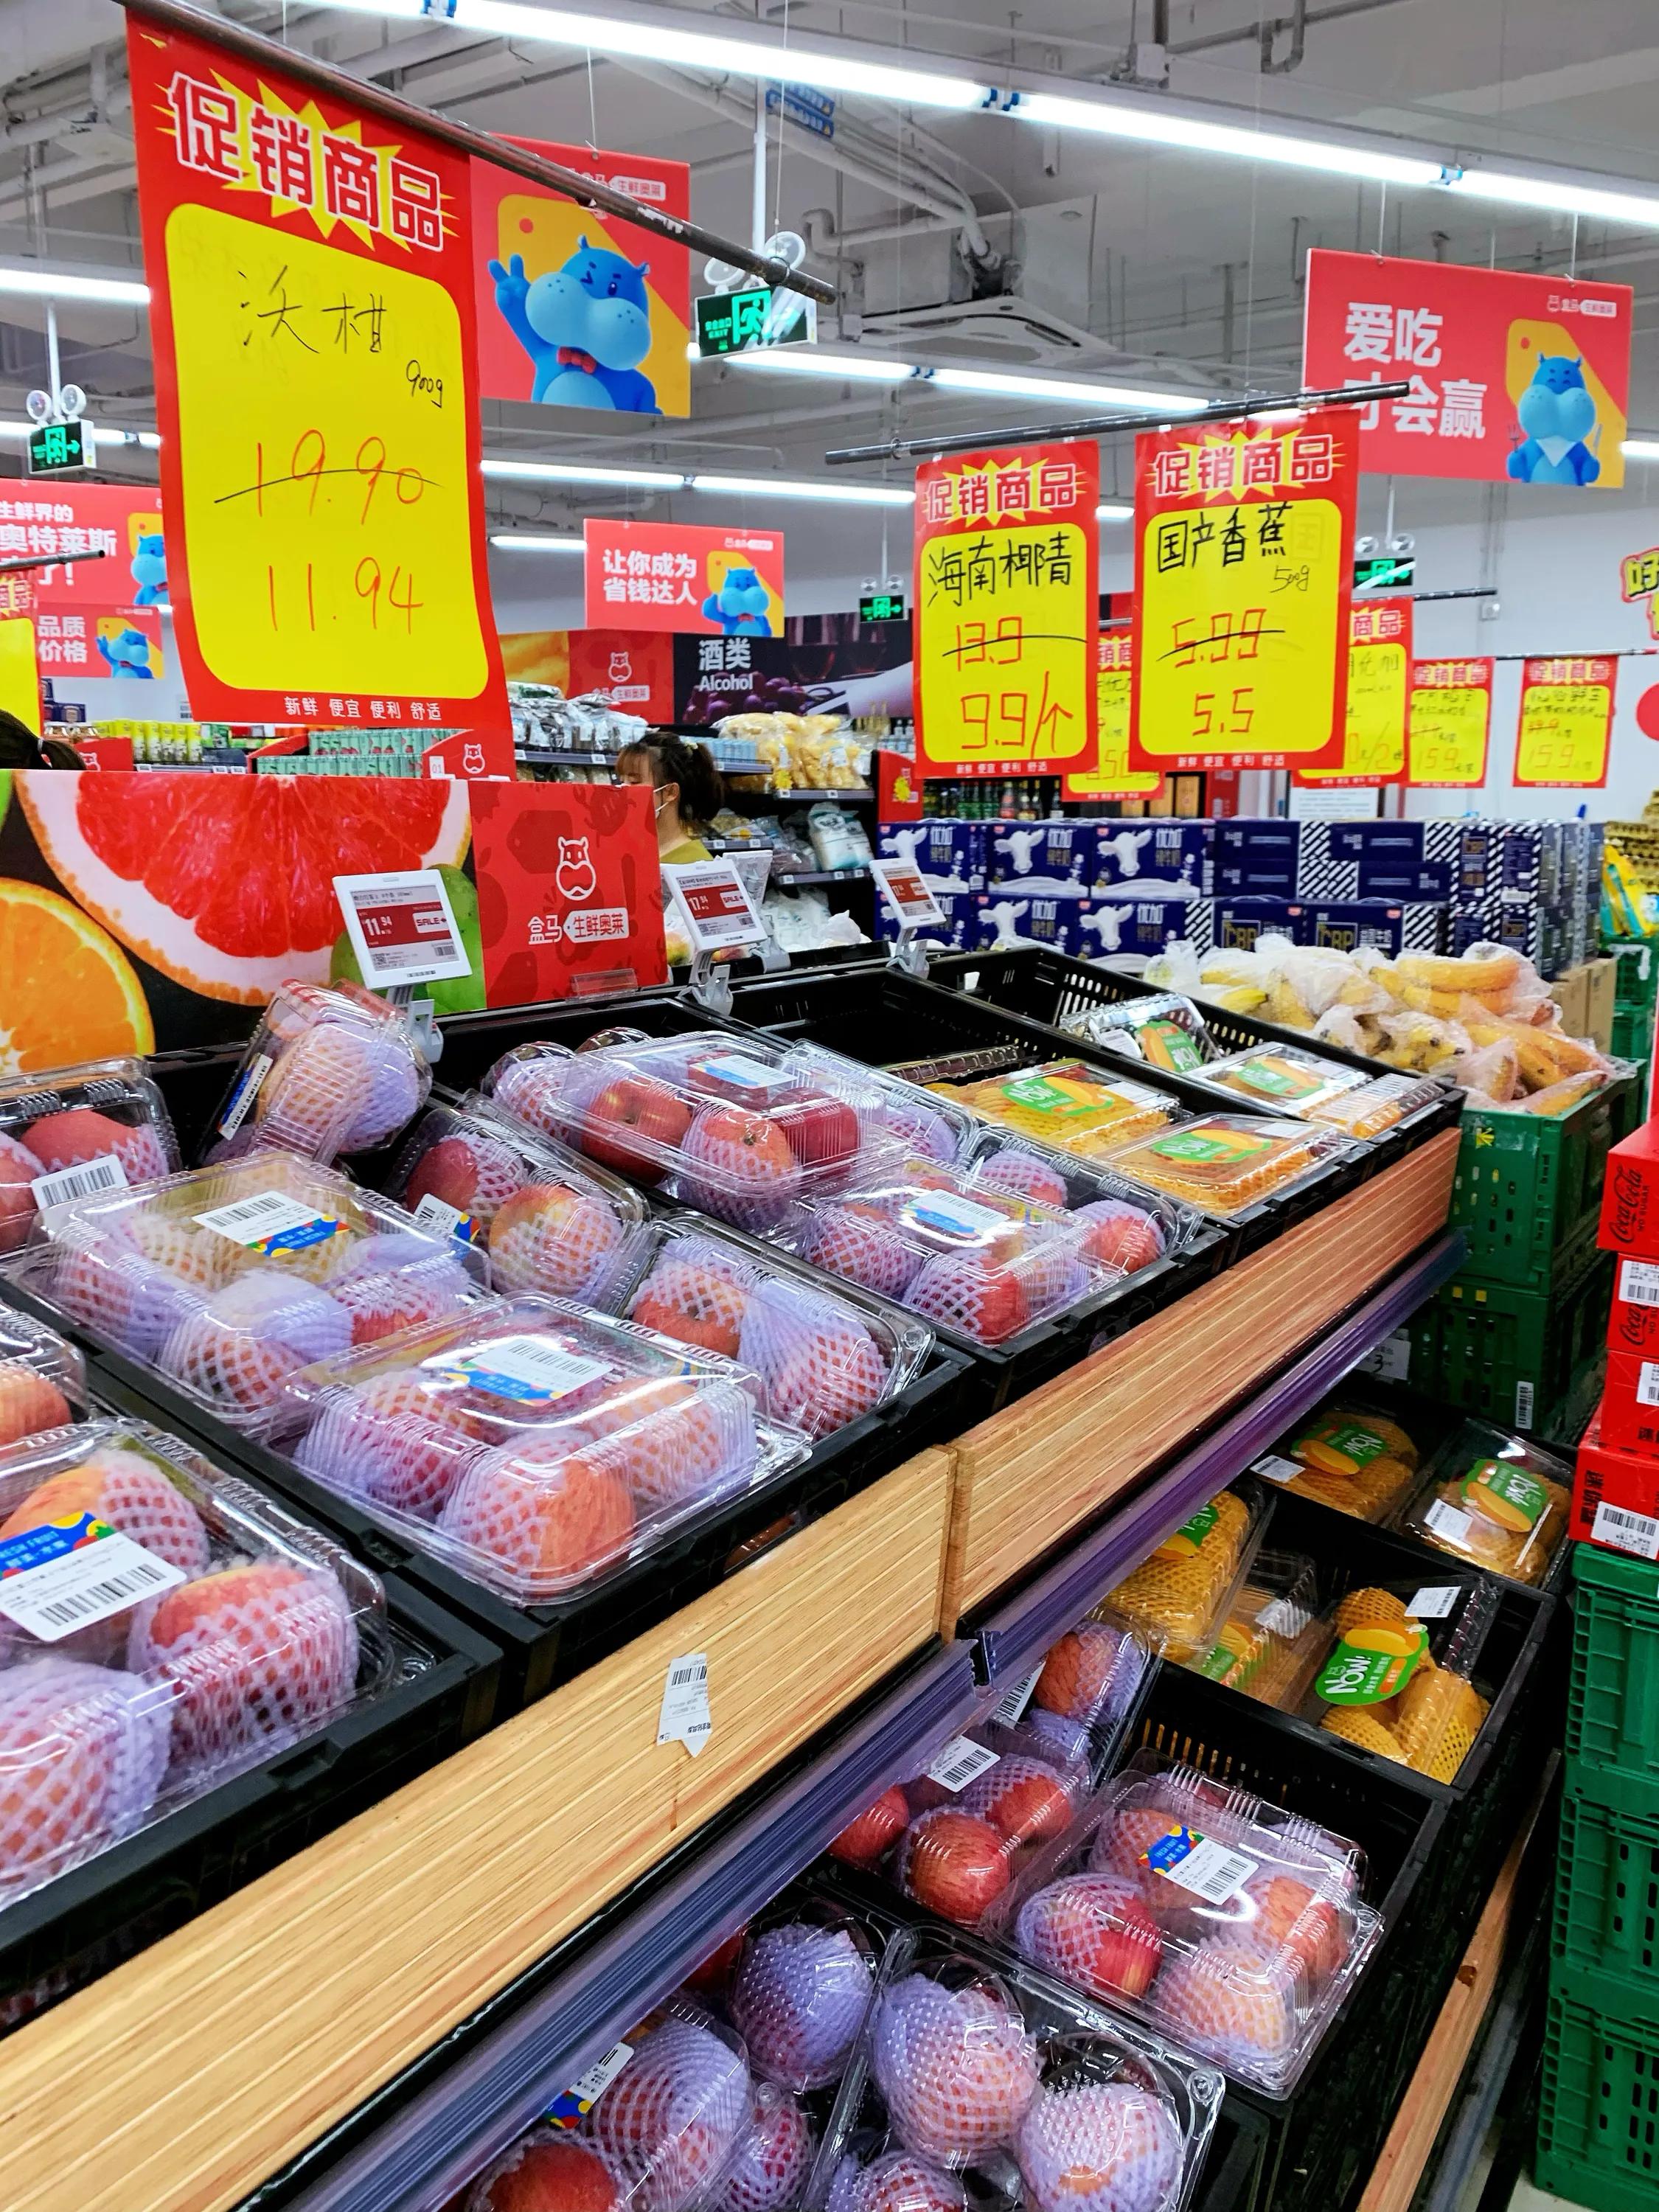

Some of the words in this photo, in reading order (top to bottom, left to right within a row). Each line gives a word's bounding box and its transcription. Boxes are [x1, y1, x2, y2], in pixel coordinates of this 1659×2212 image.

[168, 72, 443, 251] 促销商品
[1343, 302, 1443, 367] 爱吃
[256, 430, 425, 525] 19.90
[1153, 434, 1334, 497] 促销商品
[926, 462, 1077, 524] 促销商品
[0, 501, 73, 523] 生鲜界的
[0, 524, 117, 557] 奥特莱斯
[1158, 501, 1293, 572] 国产香蕉
[602, 549, 698, 579] 让你成为
[927, 531, 1072, 608] 海南椰青
[268, 557, 424, 635] 11.94
[603, 577, 698, 605] 省钱达人
[38, 616, 86, 638] 品质
[1171, 608, 1267, 668] 5.99
[1354, 610, 1401, 637] 商品
[38, 640, 88, 664] 价格
[698, 638, 752, 671] 酒类
[956, 616, 1023, 672] 13.9
[699, 673, 754, 692] Alcohol
[283, 696, 319, 717] 新鲜
[329, 698, 362, 718] 便宜
[369, 700, 402, 720] 便利
[410, 702, 442, 721] 舒适
[1192, 688, 1254, 736] 5.5
[416, 917, 441, 928] SALE
[527, 914, 563, 945] 盒马
[573, 913, 625, 939] 生鲜奥莱
[1324, 1655, 1373, 1694] NOW!
